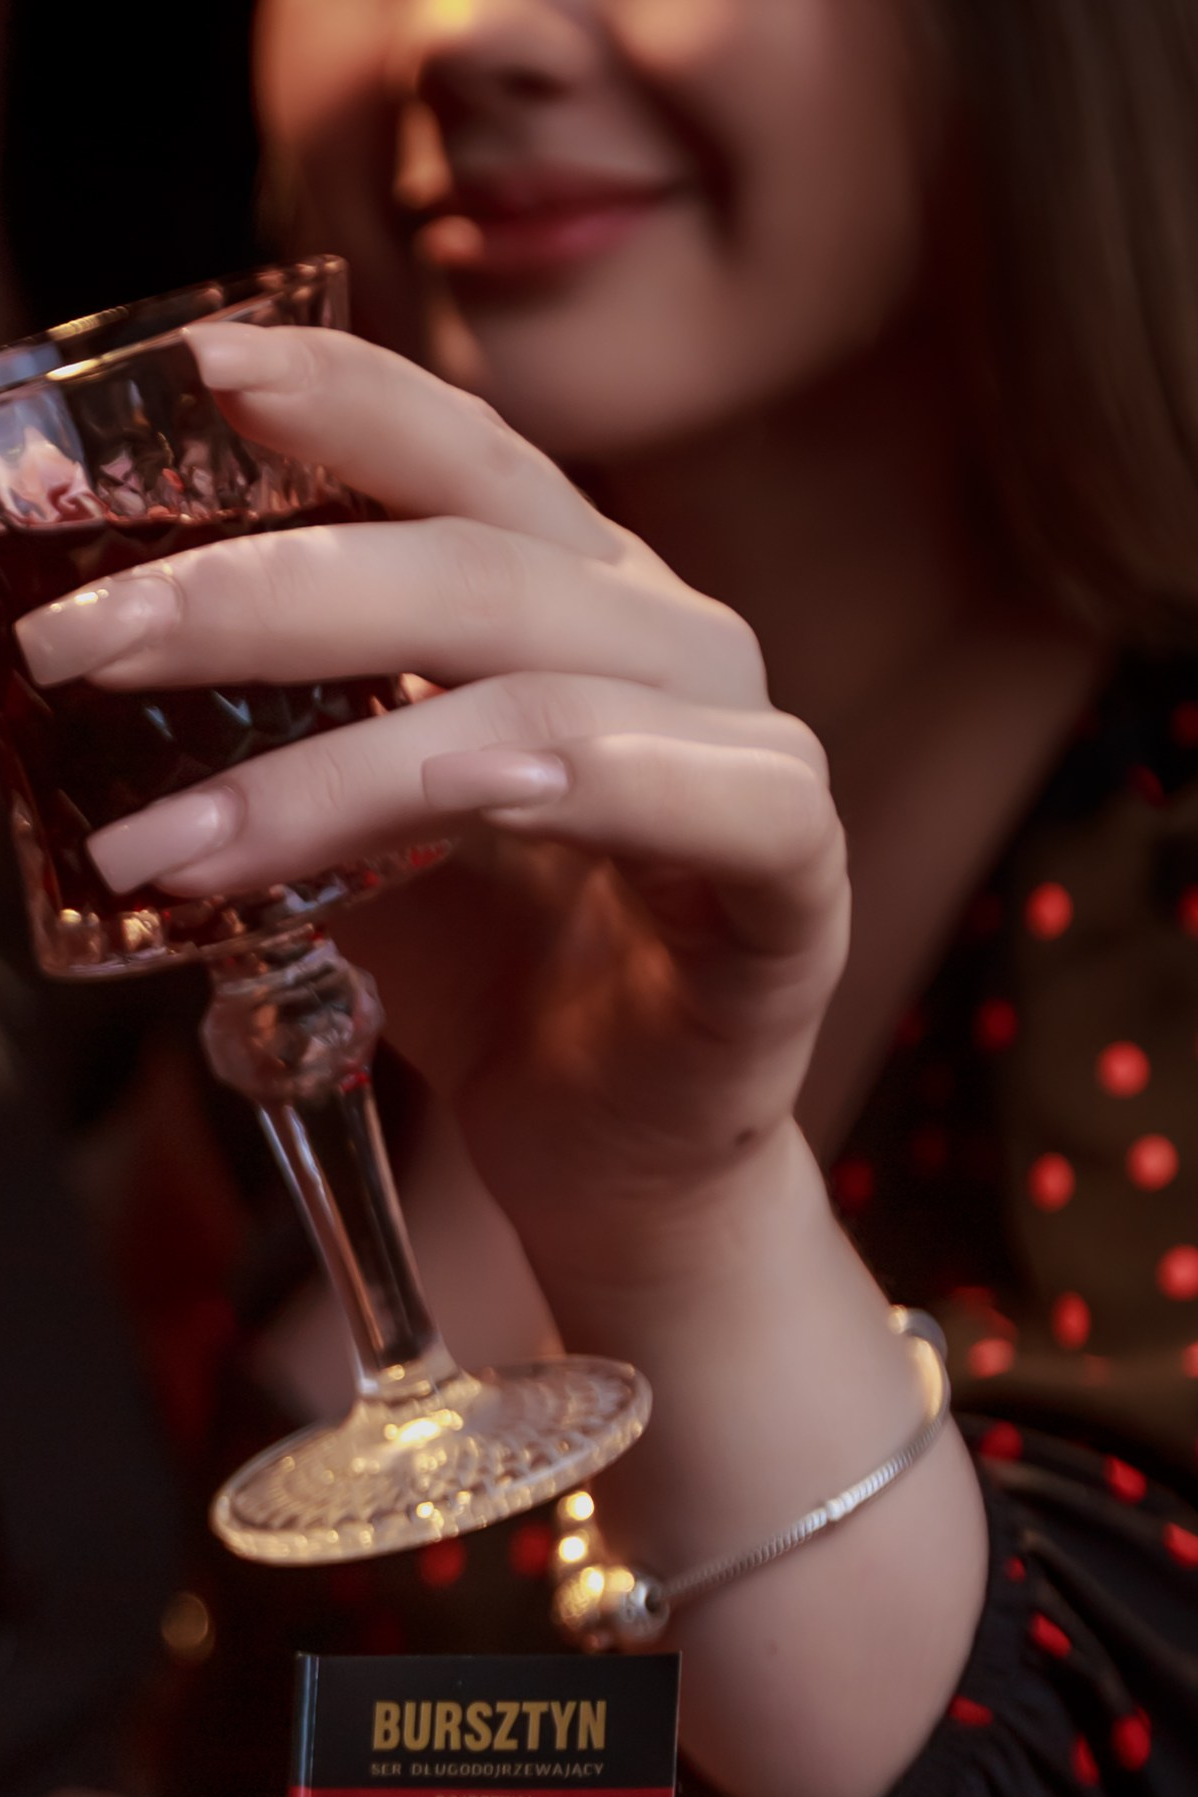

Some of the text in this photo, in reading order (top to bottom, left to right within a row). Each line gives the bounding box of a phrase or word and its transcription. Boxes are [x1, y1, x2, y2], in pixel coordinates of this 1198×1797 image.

[372, 1700, 607, 1752] BURSZTYN
[370, 1763, 604, 1779] SER DŁUGODOJRZEWAJĄCY
